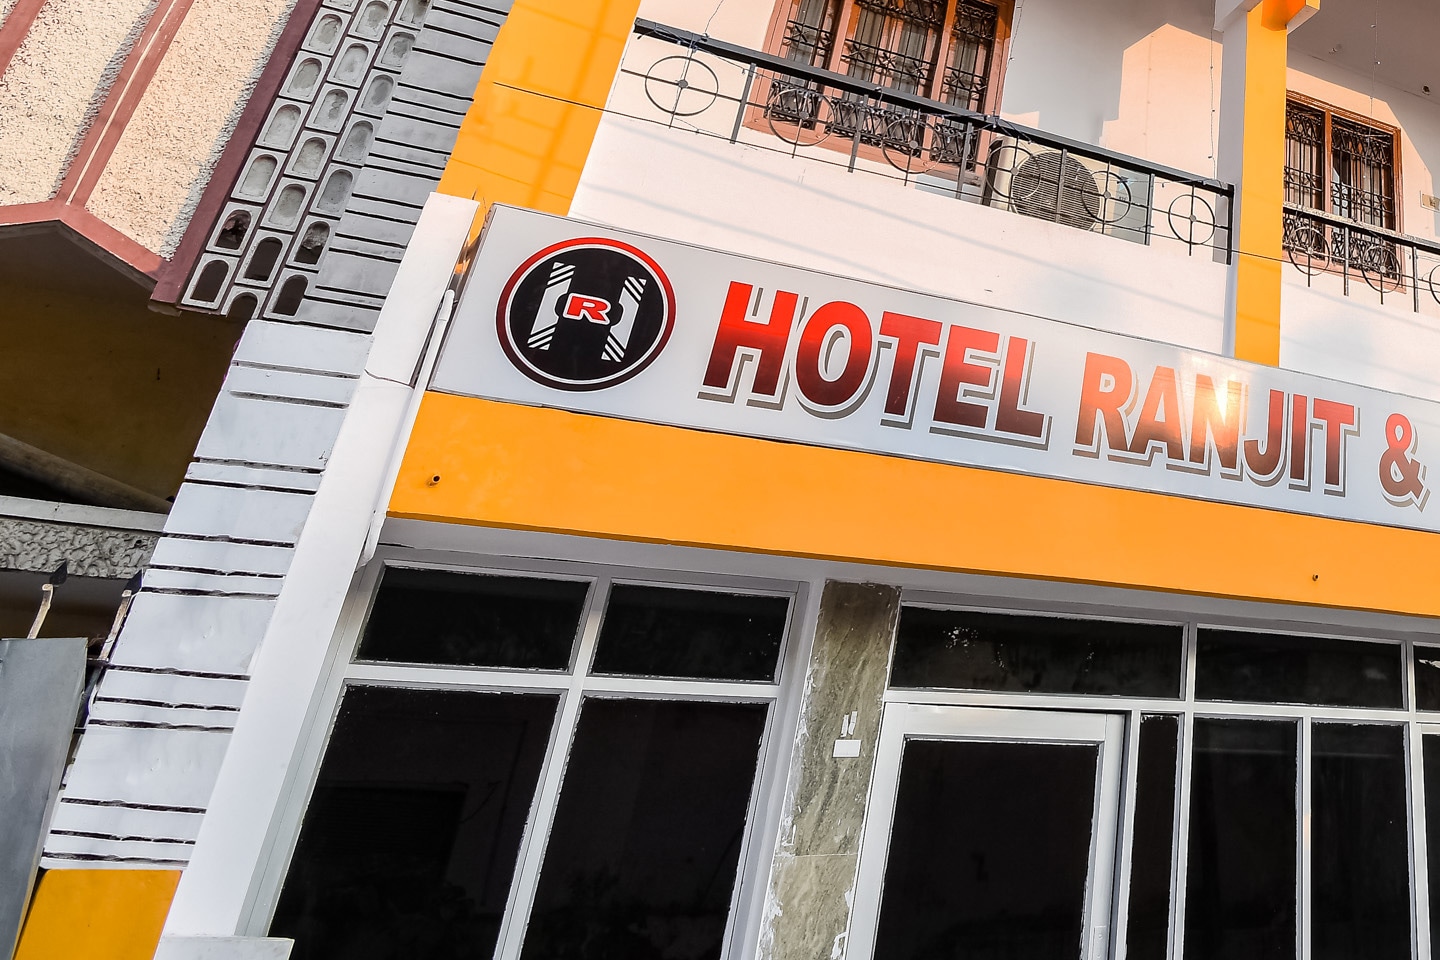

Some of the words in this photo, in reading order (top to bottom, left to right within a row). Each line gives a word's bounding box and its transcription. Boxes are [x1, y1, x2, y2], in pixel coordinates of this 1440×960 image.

[700, 280, 1053, 450] HOTEL
[1072, 351, 1360, 497] RANJIT
[1380, 413, 1429, 509] &
